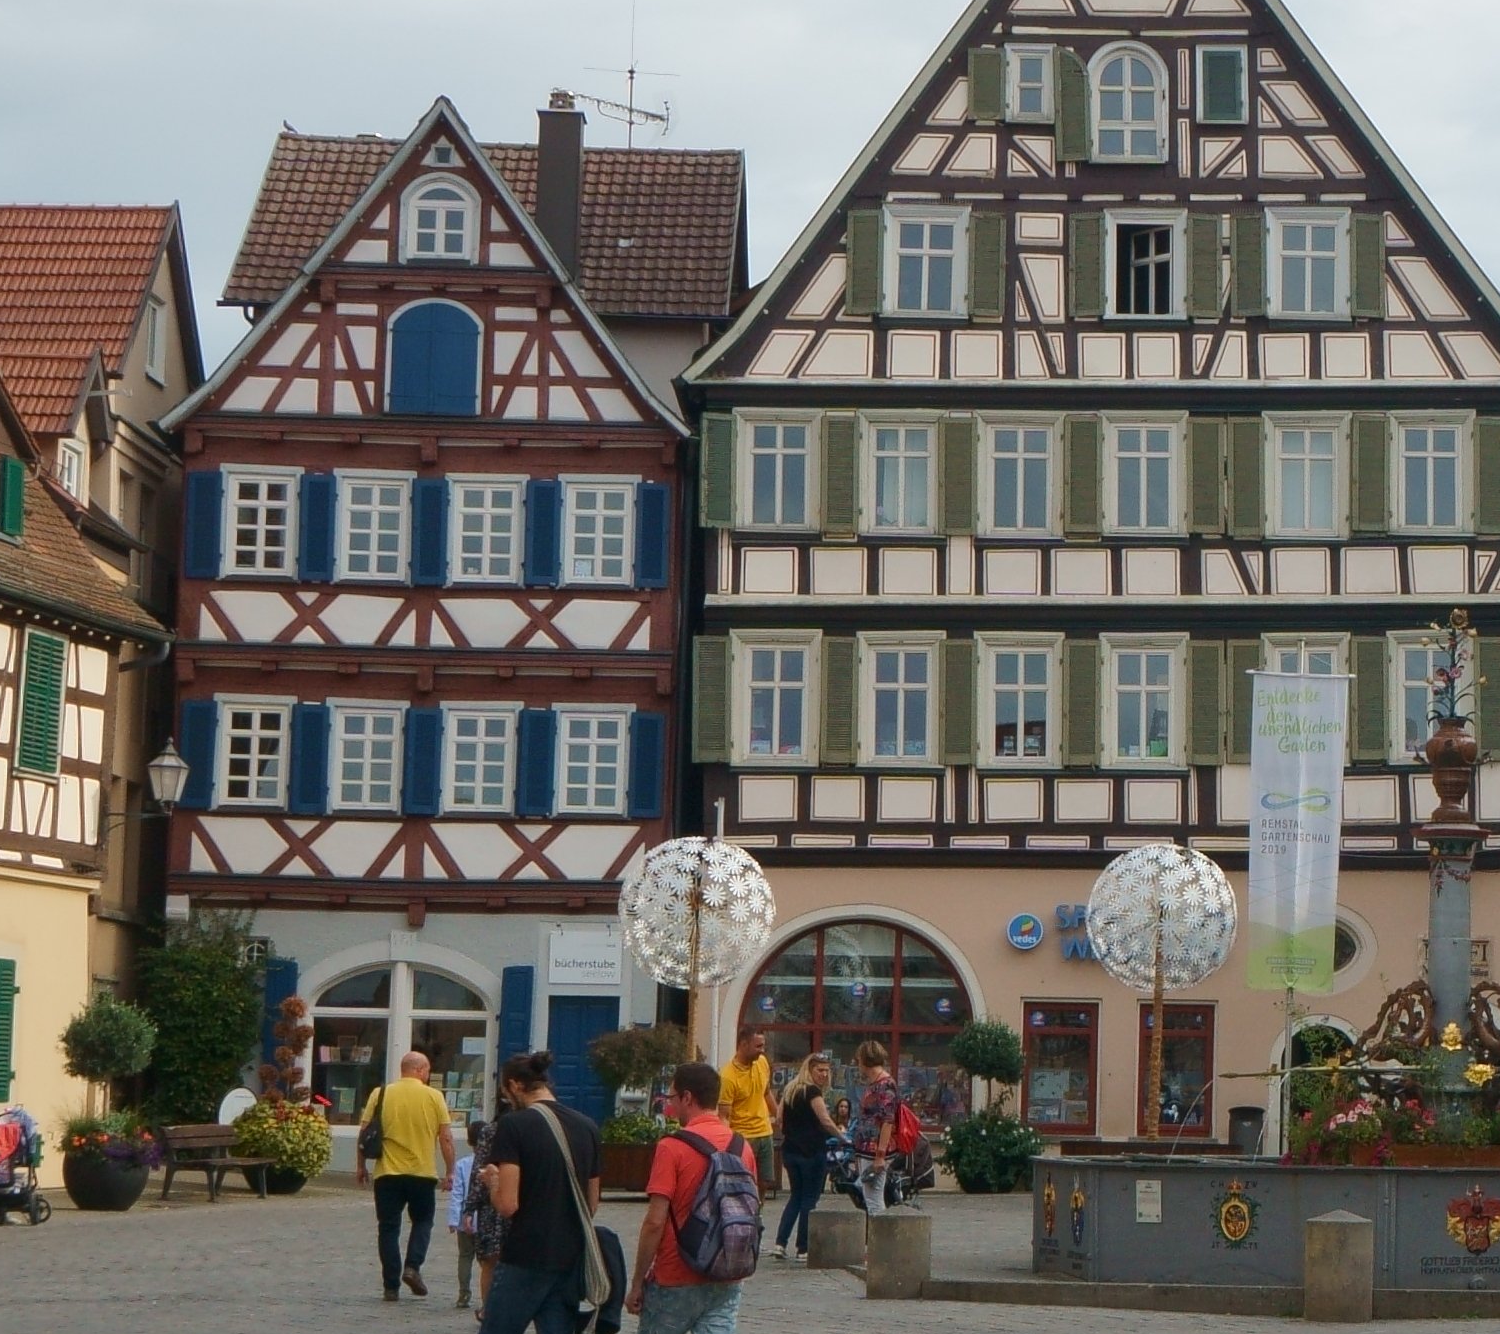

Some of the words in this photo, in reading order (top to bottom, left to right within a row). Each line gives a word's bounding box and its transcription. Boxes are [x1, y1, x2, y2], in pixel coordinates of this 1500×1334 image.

[1257, 685, 1322, 706] Entdecke
[1266, 704, 1293, 723] den
[1258, 717, 1343, 736] unendlichen
[1277, 736, 1326, 754] Garten
[1261, 819, 1304, 830] REMSTAL
[1261, 831, 1331, 844] GARTENSCHAU
[1261, 844, 1287, 855] 2019
[1012, 933, 1037, 945] vedes
[554, 957, 616, 970] bücherstube
[1420, 1256, 1460, 1266] GOTTLIEB
